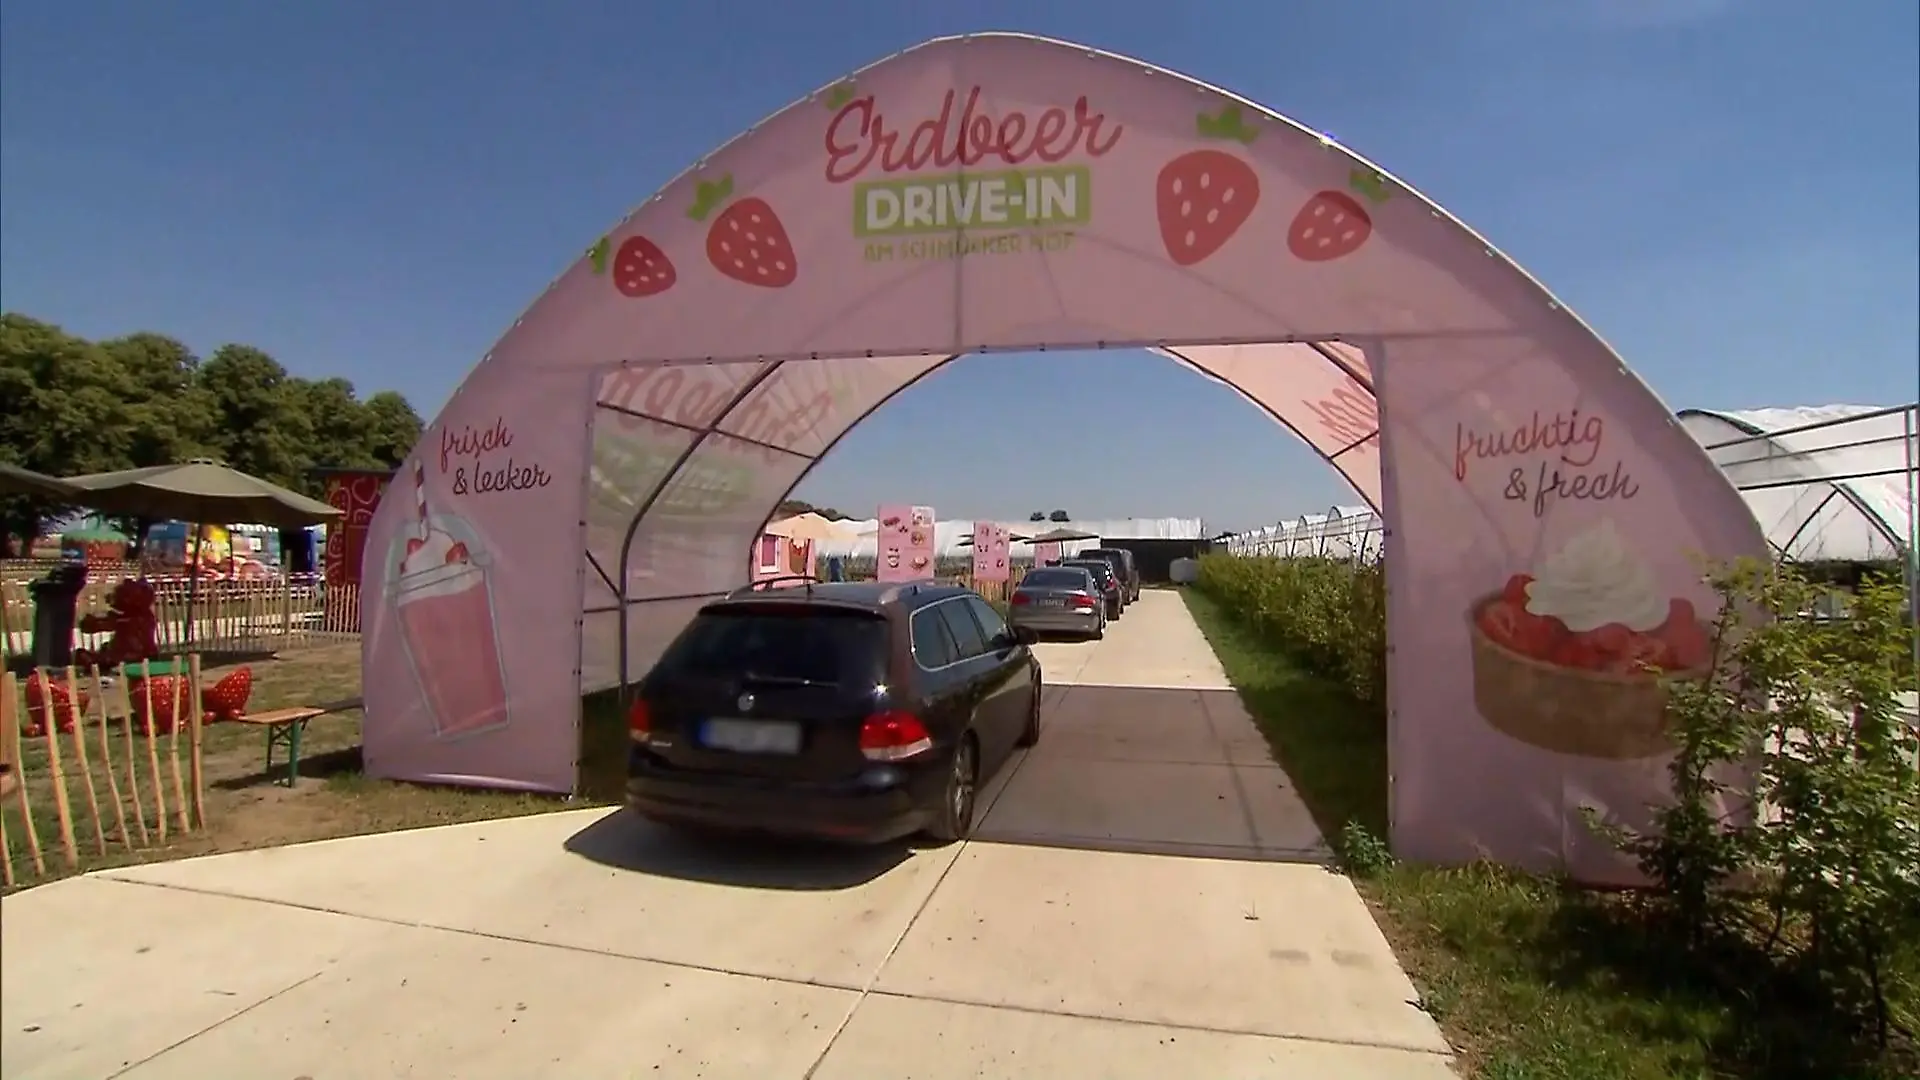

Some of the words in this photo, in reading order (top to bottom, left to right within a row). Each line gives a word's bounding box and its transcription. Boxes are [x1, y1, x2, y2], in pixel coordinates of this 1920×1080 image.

[824, 85, 1123, 184] Erdbeer
[865, 174, 1077, 230] DRIVE-IN
[441, 416, 514, 474] frisch
[1455, 409, 1603, 482] fruchtig
[453, 467, 468, 495] &
[474, 457, 551, 494] lecker
[1504, 467, 1527, 501] &
[1534, 461, 1640, 518] frech
